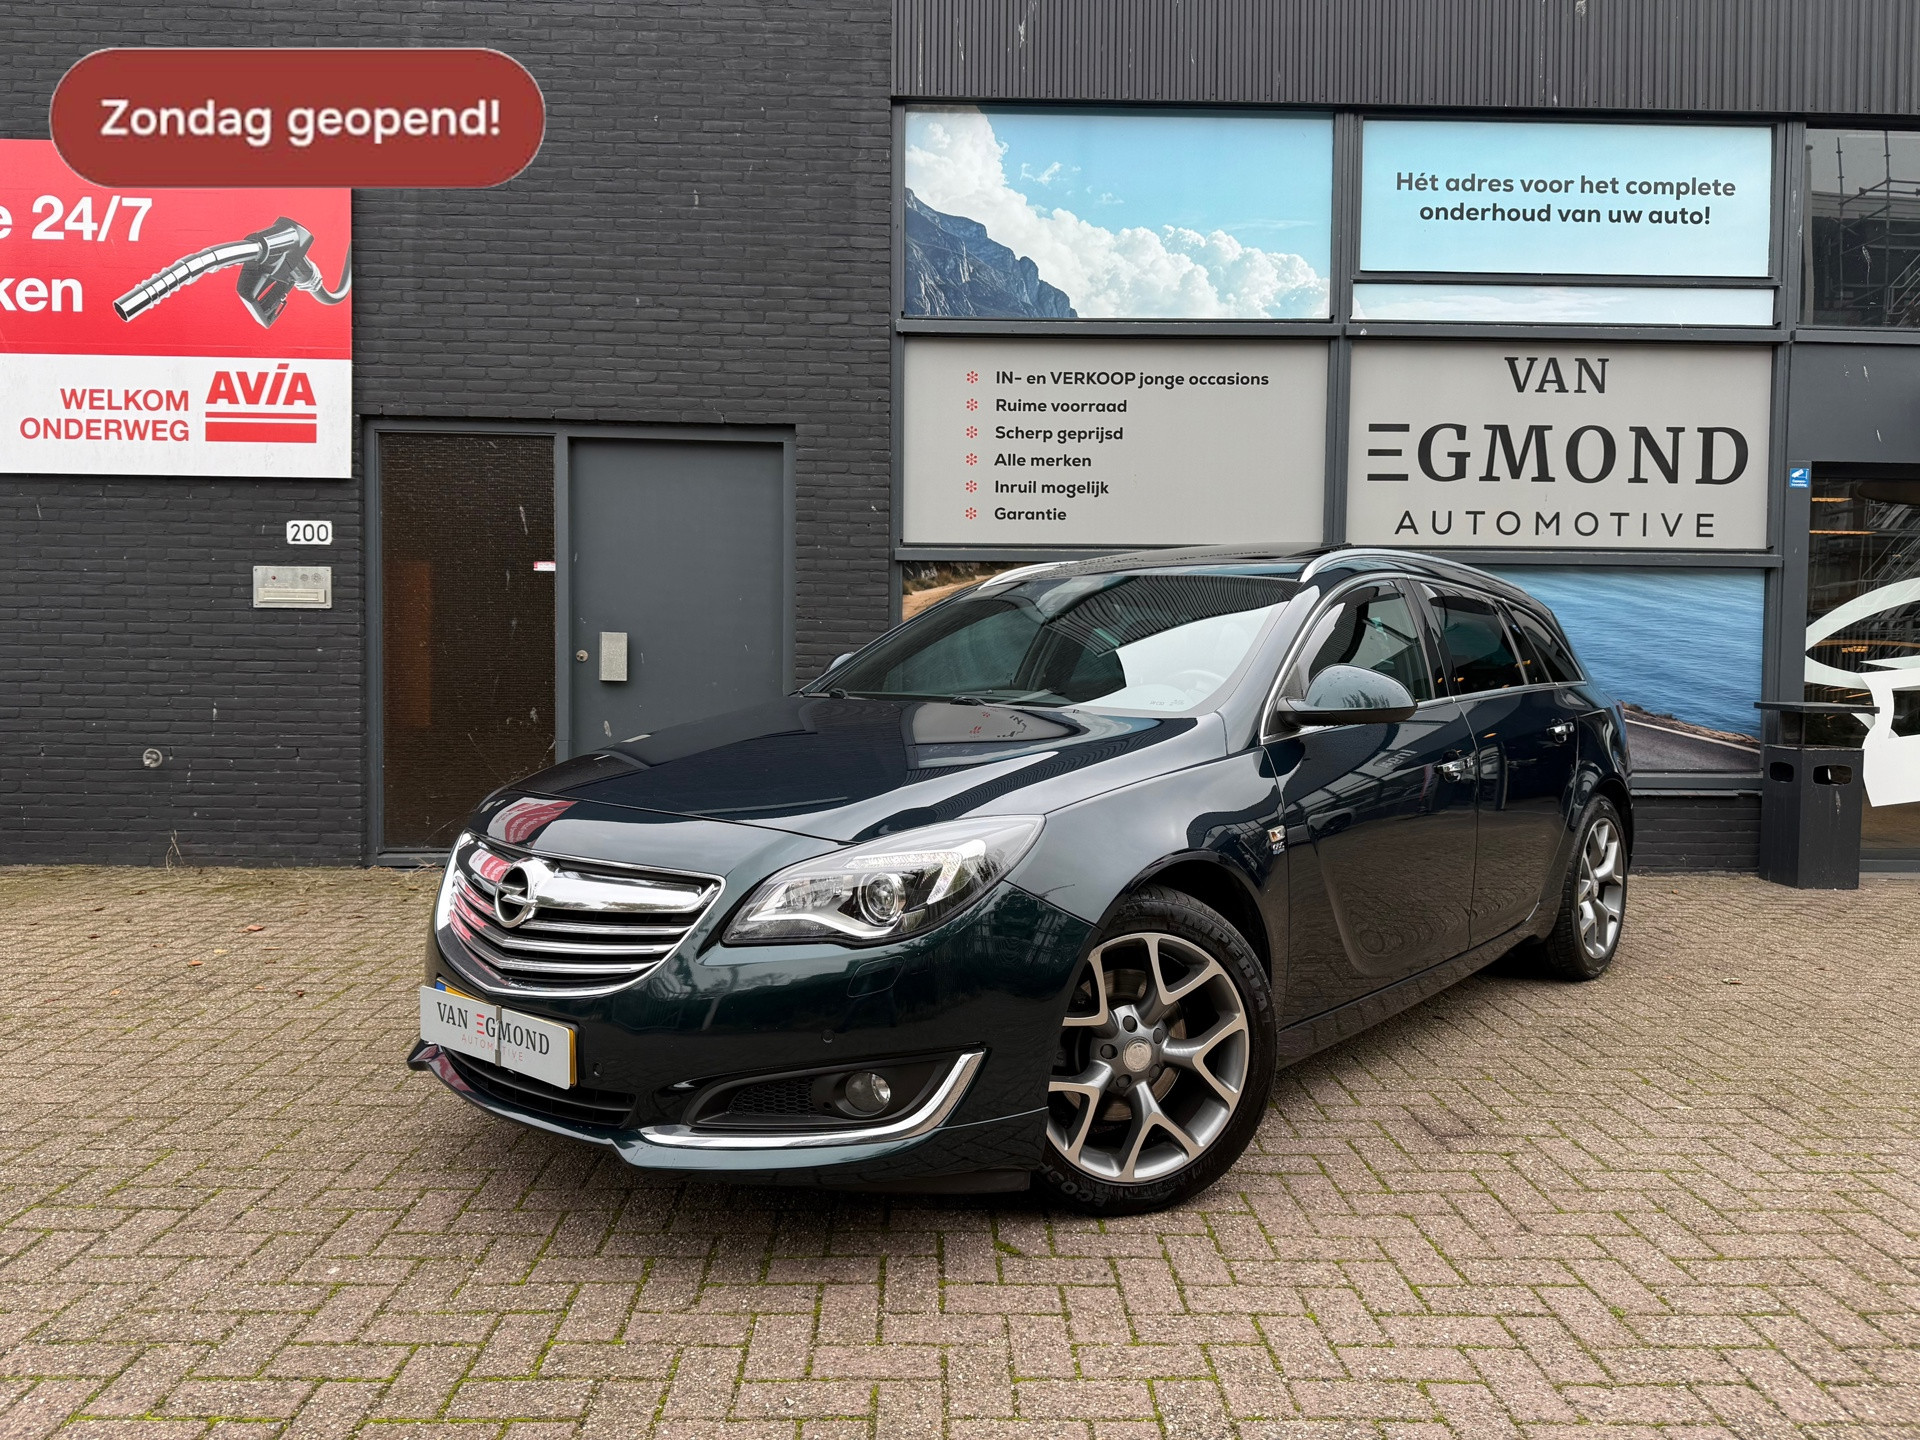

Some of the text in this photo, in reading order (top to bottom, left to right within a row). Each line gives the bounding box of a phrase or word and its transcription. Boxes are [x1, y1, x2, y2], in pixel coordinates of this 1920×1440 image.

[1396, 172, 1736, 200] Hét adres voor het complete
[31, 195, 152, 242] 24/7
[1419, 203, 1711, 225] onderhoud van uw auto!
[996, 371, 1269, 389] IN- en VERKOOP jonge occasions
[1504, 356, 1610, 394] VAN
[60, 388, 189, 412] WELKOM
[996, 399, 1127, 413] Ruime voorraad
[19, 418, 190, 442] ONDERWEG
[995, 426, 1124, 445] Scherp geprijsd
[994, 453, 1092, 467] Alle merken
[1367, 423, 1749, 486] EGMOND
[995, 480, 1109, 499] Inruil mogelijk
[994, 507, 1067, 521] Garantie
[1395, 510, 1715, 538] AUTOMOTIVE
[290, 523, 329, 543] 200
[437, 1002, 550, 1056] VAN EGMOND
[461, 1034, 524, 1062] AUTOMTIVE
